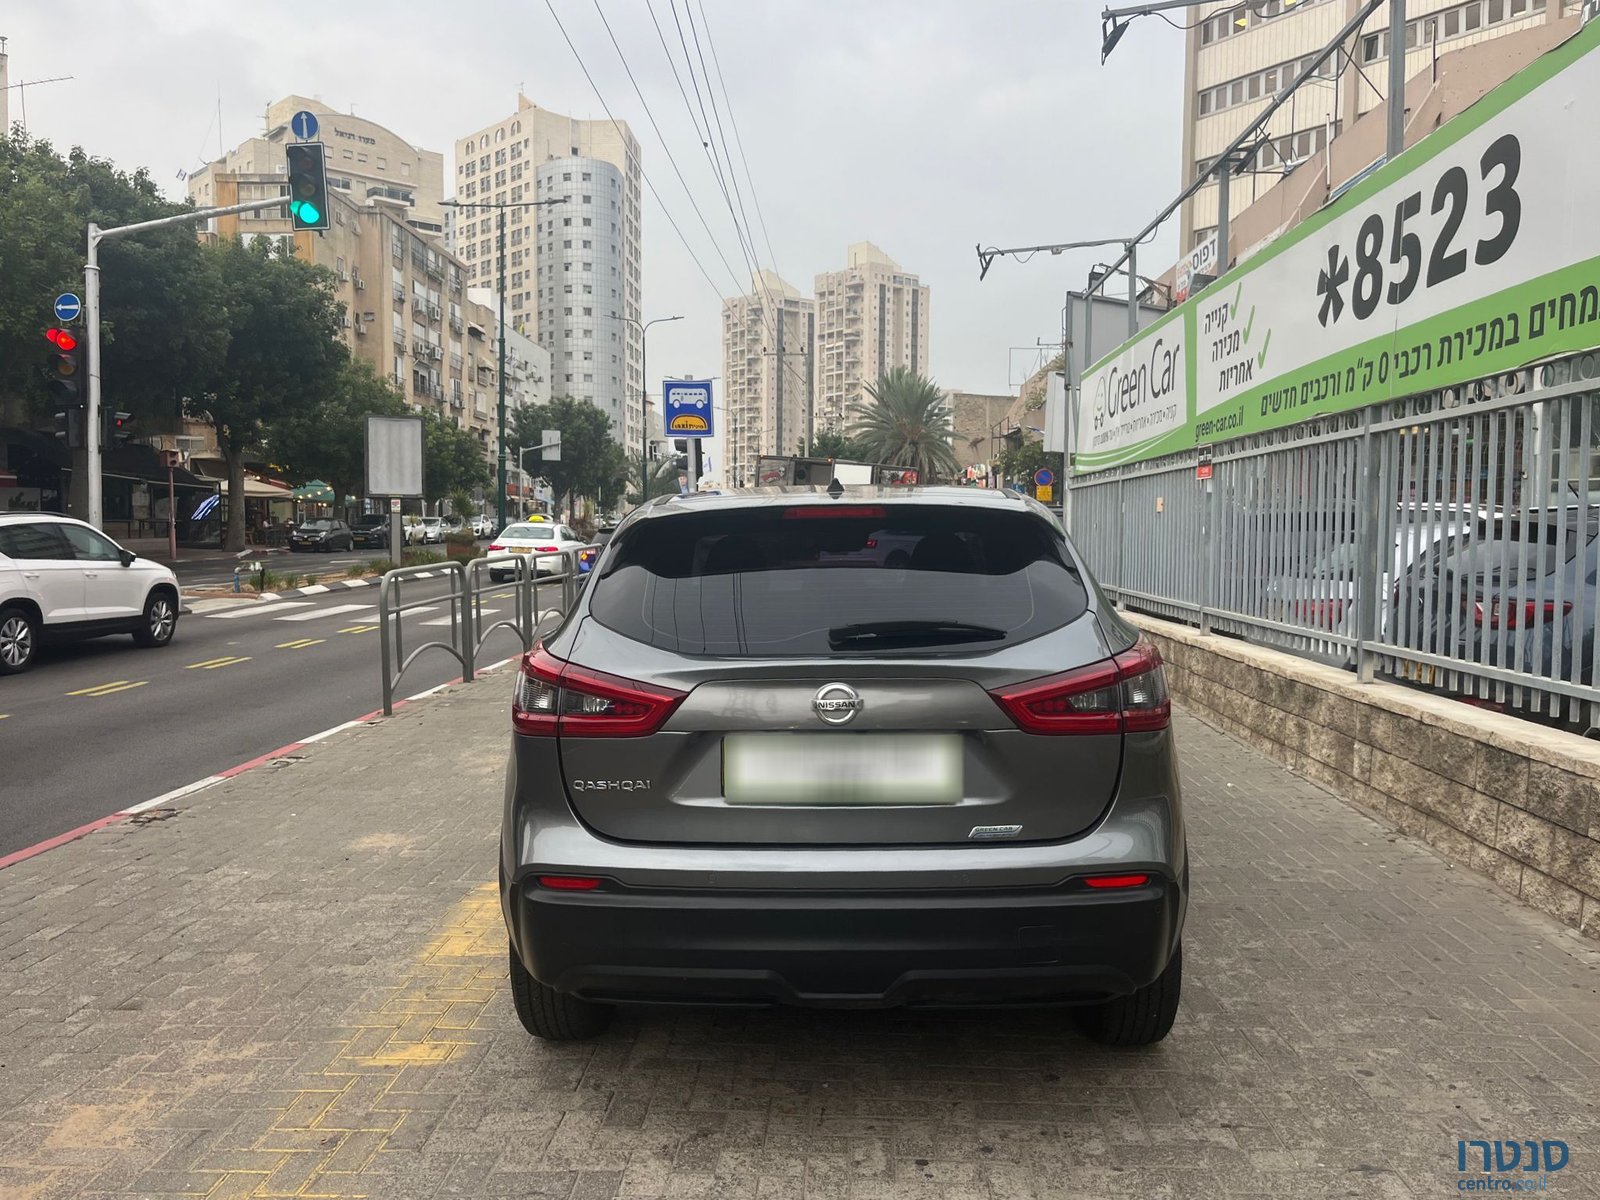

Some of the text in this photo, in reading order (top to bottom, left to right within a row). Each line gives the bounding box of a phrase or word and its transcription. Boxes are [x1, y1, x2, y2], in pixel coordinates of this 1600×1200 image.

[1192, 238, 1216, 270] דפוס
[1204, 302, 1229, 335] קנייה
[1528, 285, 1600, 340] מחים
[1212, 329, 1240, 362] מכירה
[1437, 312, 1520, 367] במכירת
[1219, 358, 1254, 392] אחריות
[1378, 351, 1389, 384] 0
[1393, 342, 1432, 379] רכבי
[1108, 338, 1180, 418] Green Car
[1300, 371, 1341, 405] ורכבים
[1260, 386, 1297, 416] חדשים
[1195, 405, 1244, 442] green-car.co.il
[818, 701, 856, 709] NISSAN
[573, 779, 651, 792] QASHQAI
